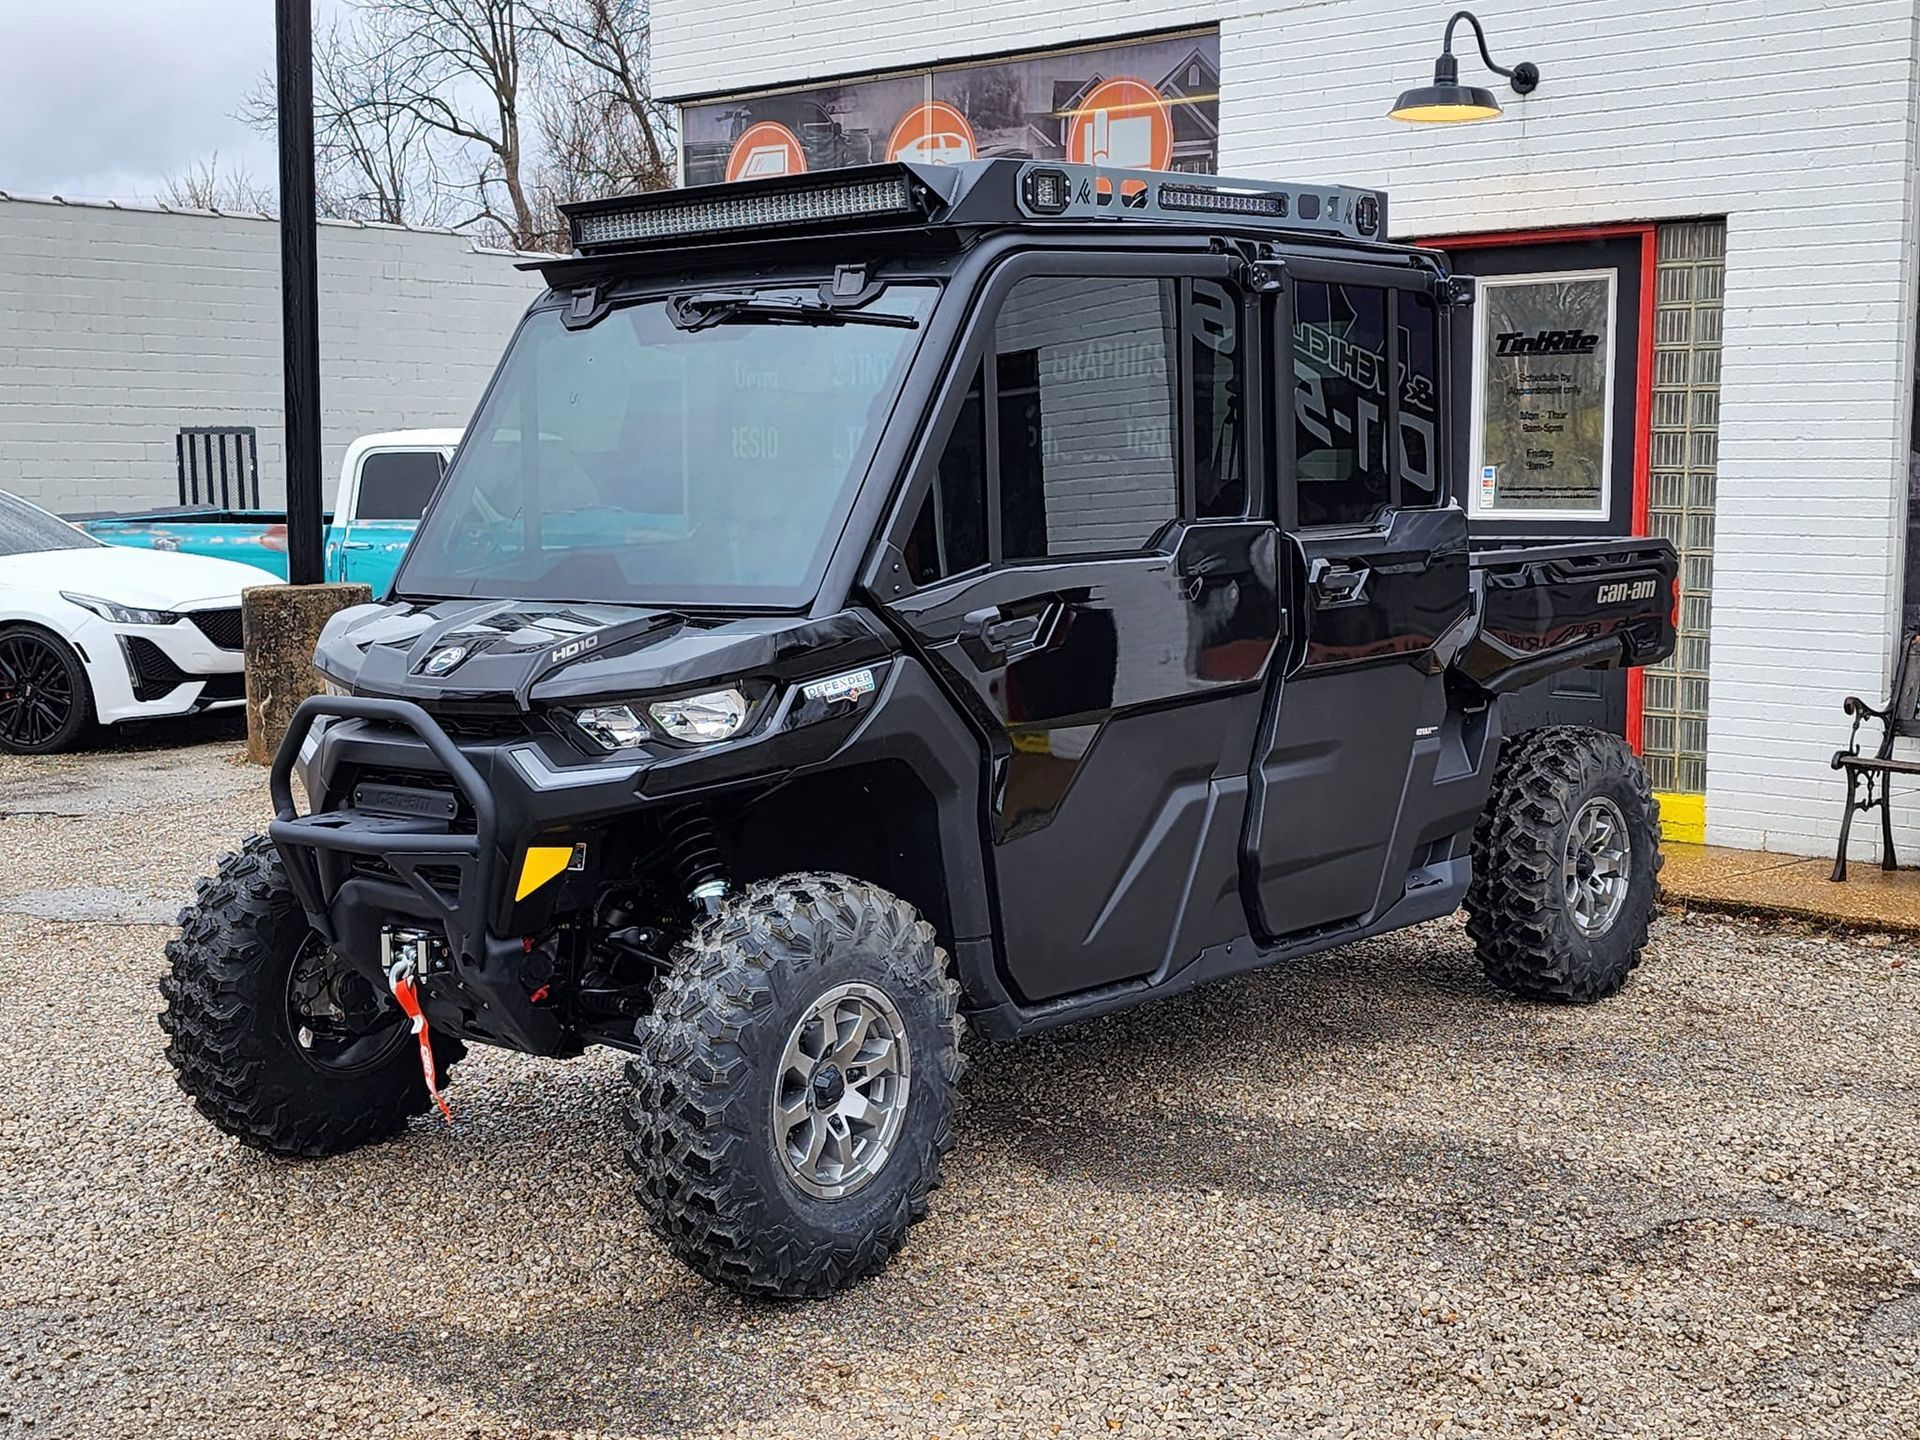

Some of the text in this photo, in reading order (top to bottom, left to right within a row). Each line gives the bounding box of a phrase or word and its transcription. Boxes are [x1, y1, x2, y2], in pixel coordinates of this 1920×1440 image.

[1496, 329, 1599, 354] TintRite
[1518, 372, 1572, 384] Schedule by
[1508, 384, 1582, 397] Appointment only
[1519, 411, 1540, 420] Mon
[1547, 410, 1568, 420] Thur
[1526, 449, 1554, 460] Friday
[1596, 579, 1657, 604] can-am
[552, 635, 598, 663] HD10
[807, 671, 872, 697] DEFENDER
